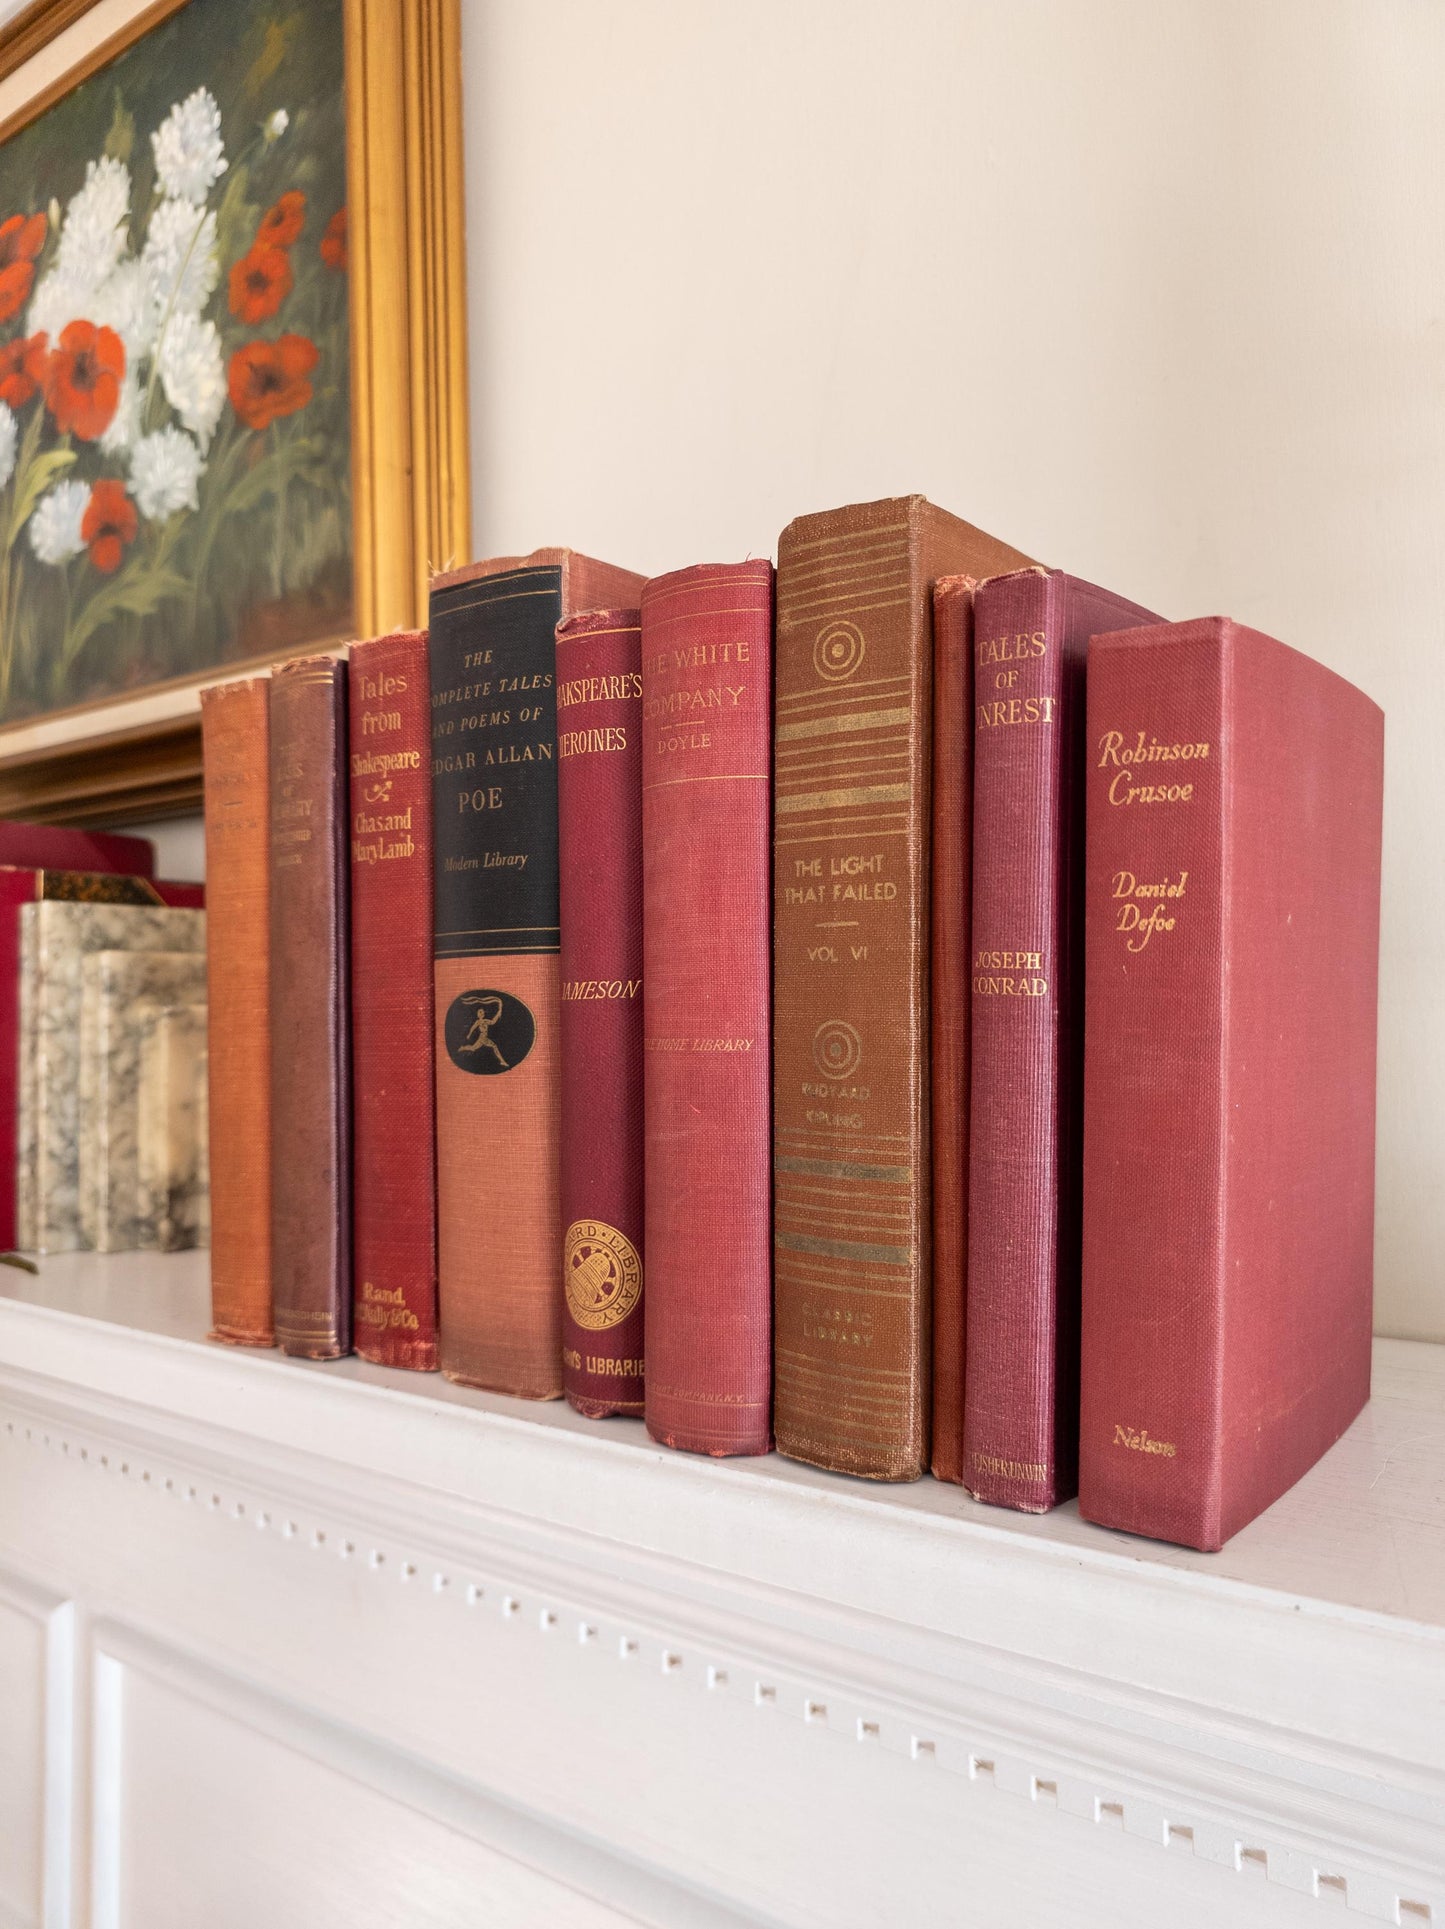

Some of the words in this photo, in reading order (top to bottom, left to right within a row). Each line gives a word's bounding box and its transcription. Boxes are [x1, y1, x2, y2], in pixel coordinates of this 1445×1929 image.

[464, 649, 493, 669] THE
[675, 642, 750, 668] WHITE
[979, 631, 1046, 666] TALES
[359, 672, 408, 700] Tales
[431, 682, 491, 708] OMPLETE
[499, 673, 553, 693] TALES
[995, 670, 1019, 689] OF
[643, 686, 746, 720] COMPANY
[977, 697, 1056, 729] NREST
[361, 711, 401, 735] from
[460, 710, 511, 732] POEMS
[520, 706, 543, 722] OF
[485, 742, 553, 765] ALLAN
[658, 733, 711, 754] DOYLE
[1098, 730, 1210, 768] Robinson
[352, 750, 421, 779] Shakespeare
[458, 787, 503, 814] POE
[1108, 769, 1194, 806] Crusoe
[379, 834, 415, 860] Lamb
[444, 855, 478, 872] Modern
[483, 851, 528, 871] Library
[794, 860, 823, 877] THE
[830, 854, 884, 876] LIGHT
[784, 886, 825, 904] THAT
[833, 882, 898, 901] FAILED
[1112, 871, 1189, 898] Daniel
[1116, 903, 1176, 953] Defoe
[807, 946, 838, 962] VOL
[850, 946, 867, 960] VI
[975, 951, 1042, 969] JOSEPH
[973, 976, 1048, 996] CONRAD
[692, 1038, 754, 1052] LIBRARY
